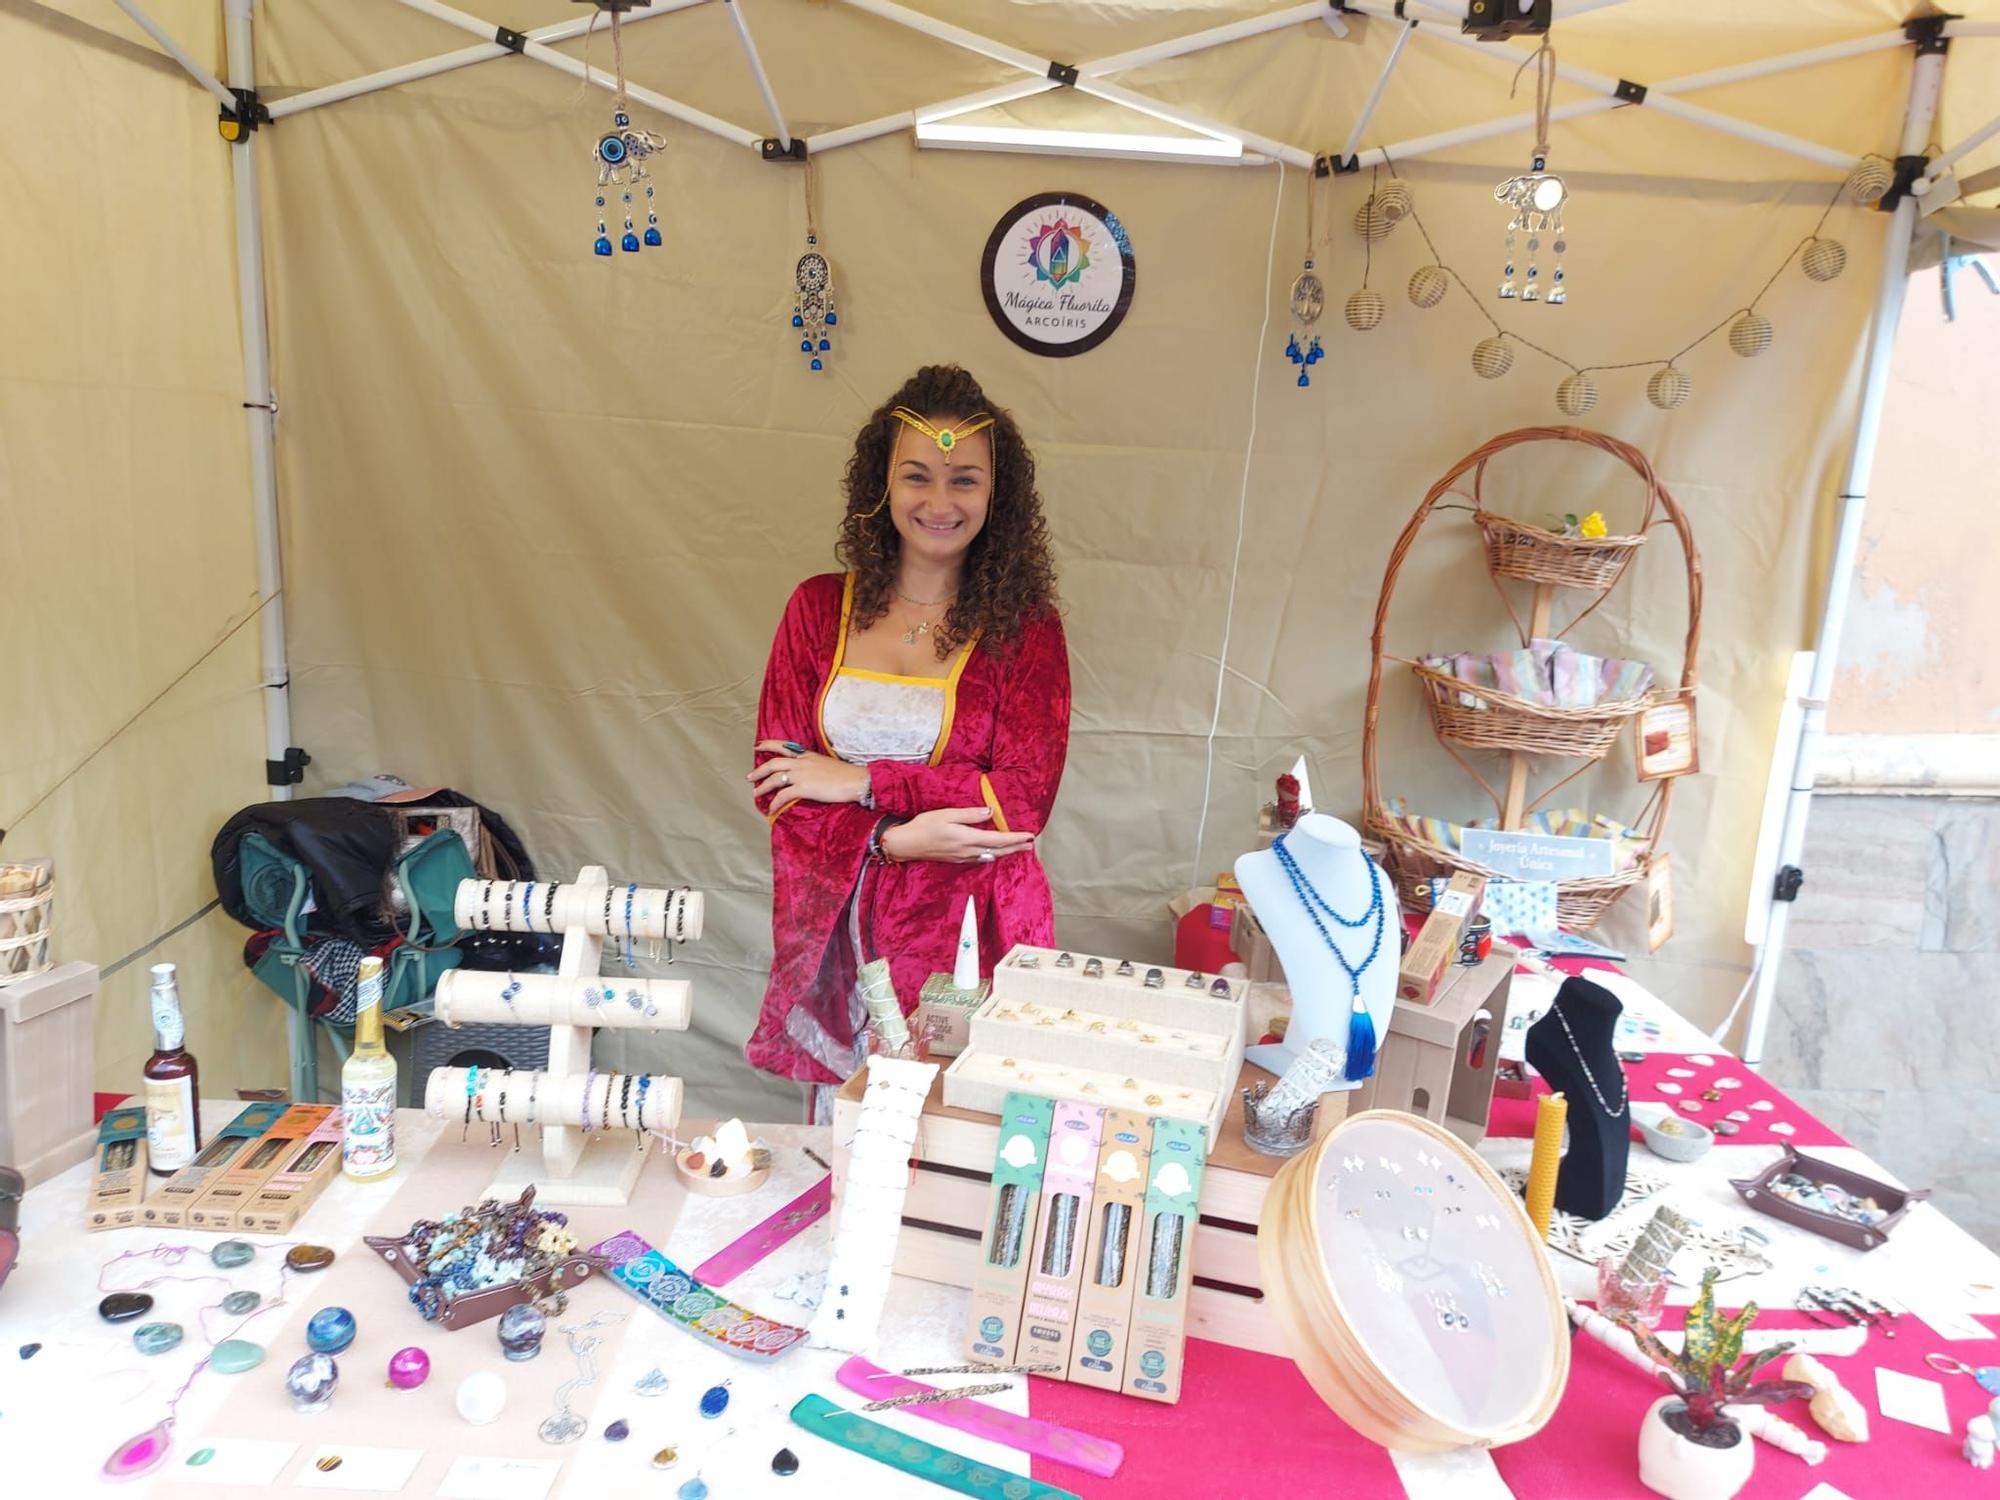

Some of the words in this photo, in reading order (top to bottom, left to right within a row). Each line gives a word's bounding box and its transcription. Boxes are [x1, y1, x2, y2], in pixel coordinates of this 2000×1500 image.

[1004, 291, 1054, 315] Mágica
[1059, 294, 1111, 313] Fluorita
[1025, 316, 1087, 329] ARCOÍRIS
